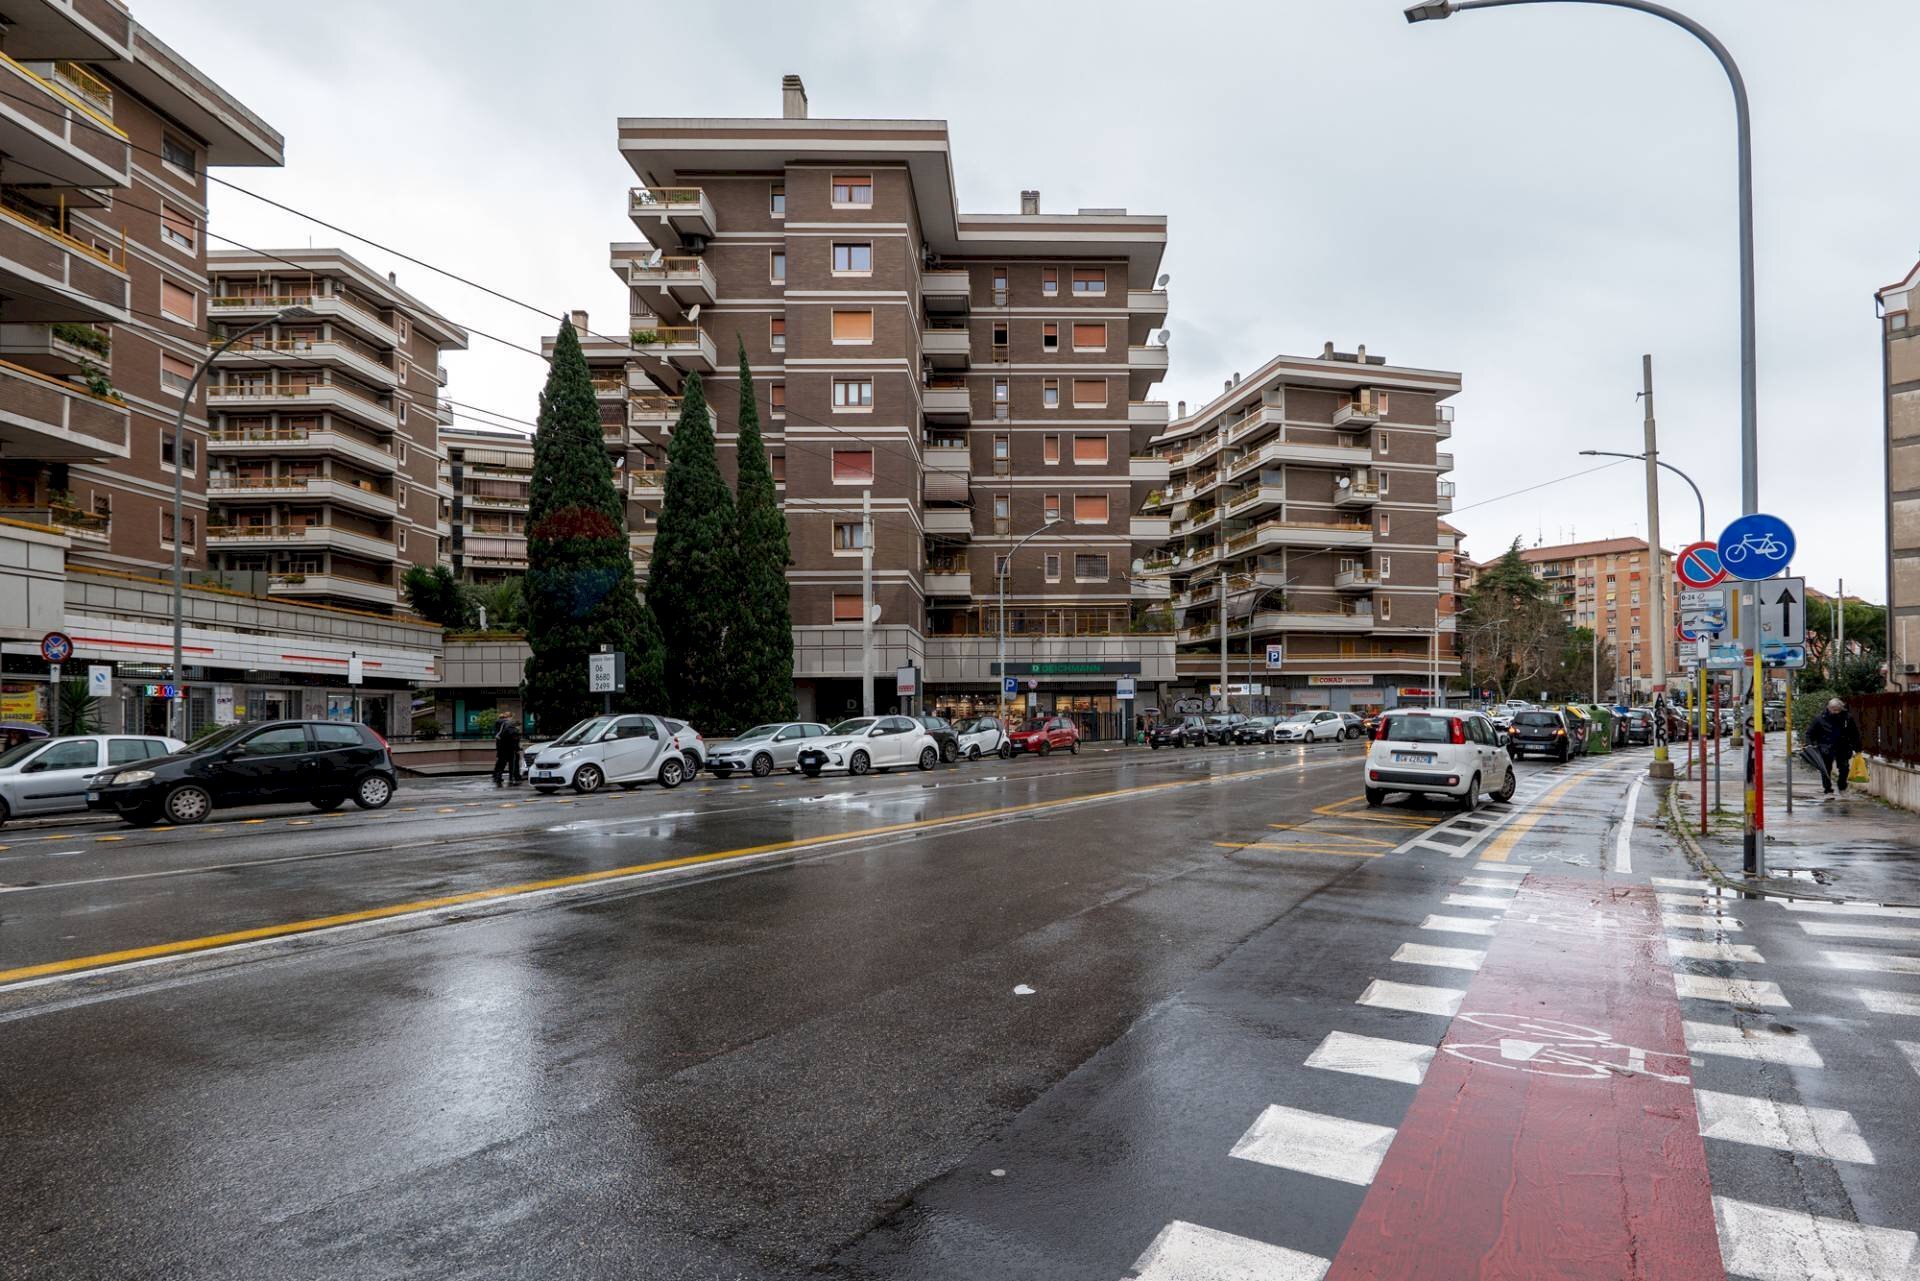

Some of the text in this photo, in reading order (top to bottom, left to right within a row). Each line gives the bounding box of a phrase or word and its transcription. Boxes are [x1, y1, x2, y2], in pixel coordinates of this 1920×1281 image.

[1271, 652, 1279, 662] P
[595, 664, 603, 672] 06
[1005, 679, 1015, 691] P
